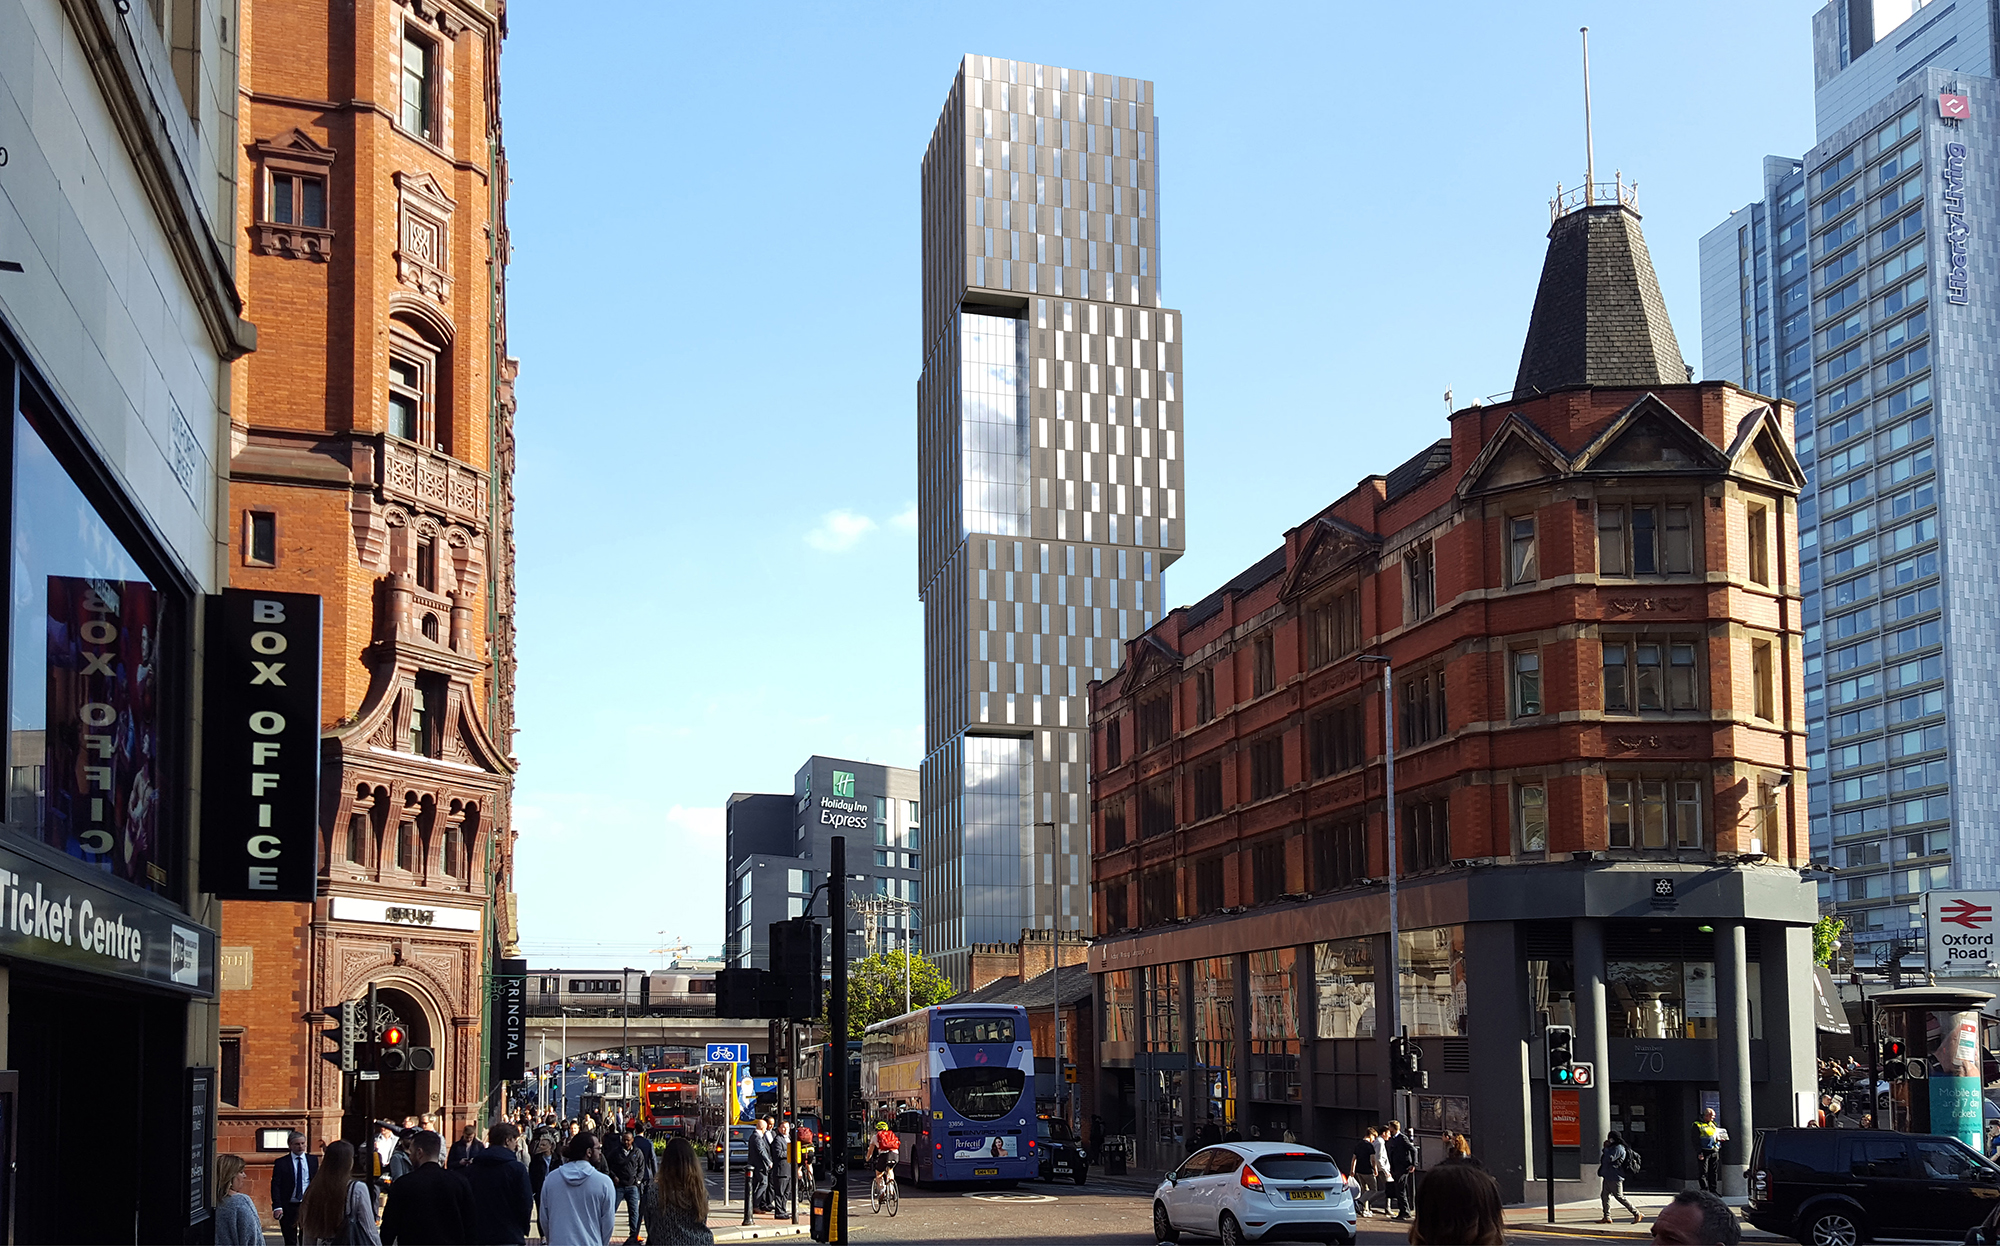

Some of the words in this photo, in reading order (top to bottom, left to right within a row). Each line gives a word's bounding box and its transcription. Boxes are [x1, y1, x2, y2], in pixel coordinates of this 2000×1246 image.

[1944, 141, 1966, 214] Living
[1948, 214, 1970, 305] Liberty
[250, 599, 287, 686] BOX
[247, 710, 286, 890] OFFICE
[821, 796, 853, 813] Holiday
[854, 801, 868, 813] Inn
[821, 809, 868, 829] Express
[79, 899, 141, 963] Centre
[1942, 933, 1993, 945] Oxford
[1948, 947, 1987, 959] Road
[507, 979, 520, 1060] PRINCIPAL
[1635, 1052, 1664, 1073] 70
[1939, 1087, 1970, 1097] Mobile
[1942, 1098, 1960, 1107] and
[1963, 1098, 1968, 1107] 7
[1952, 1109, 1977, 1118] tickets
[1309, 1191, 1323, 1199] AAK
